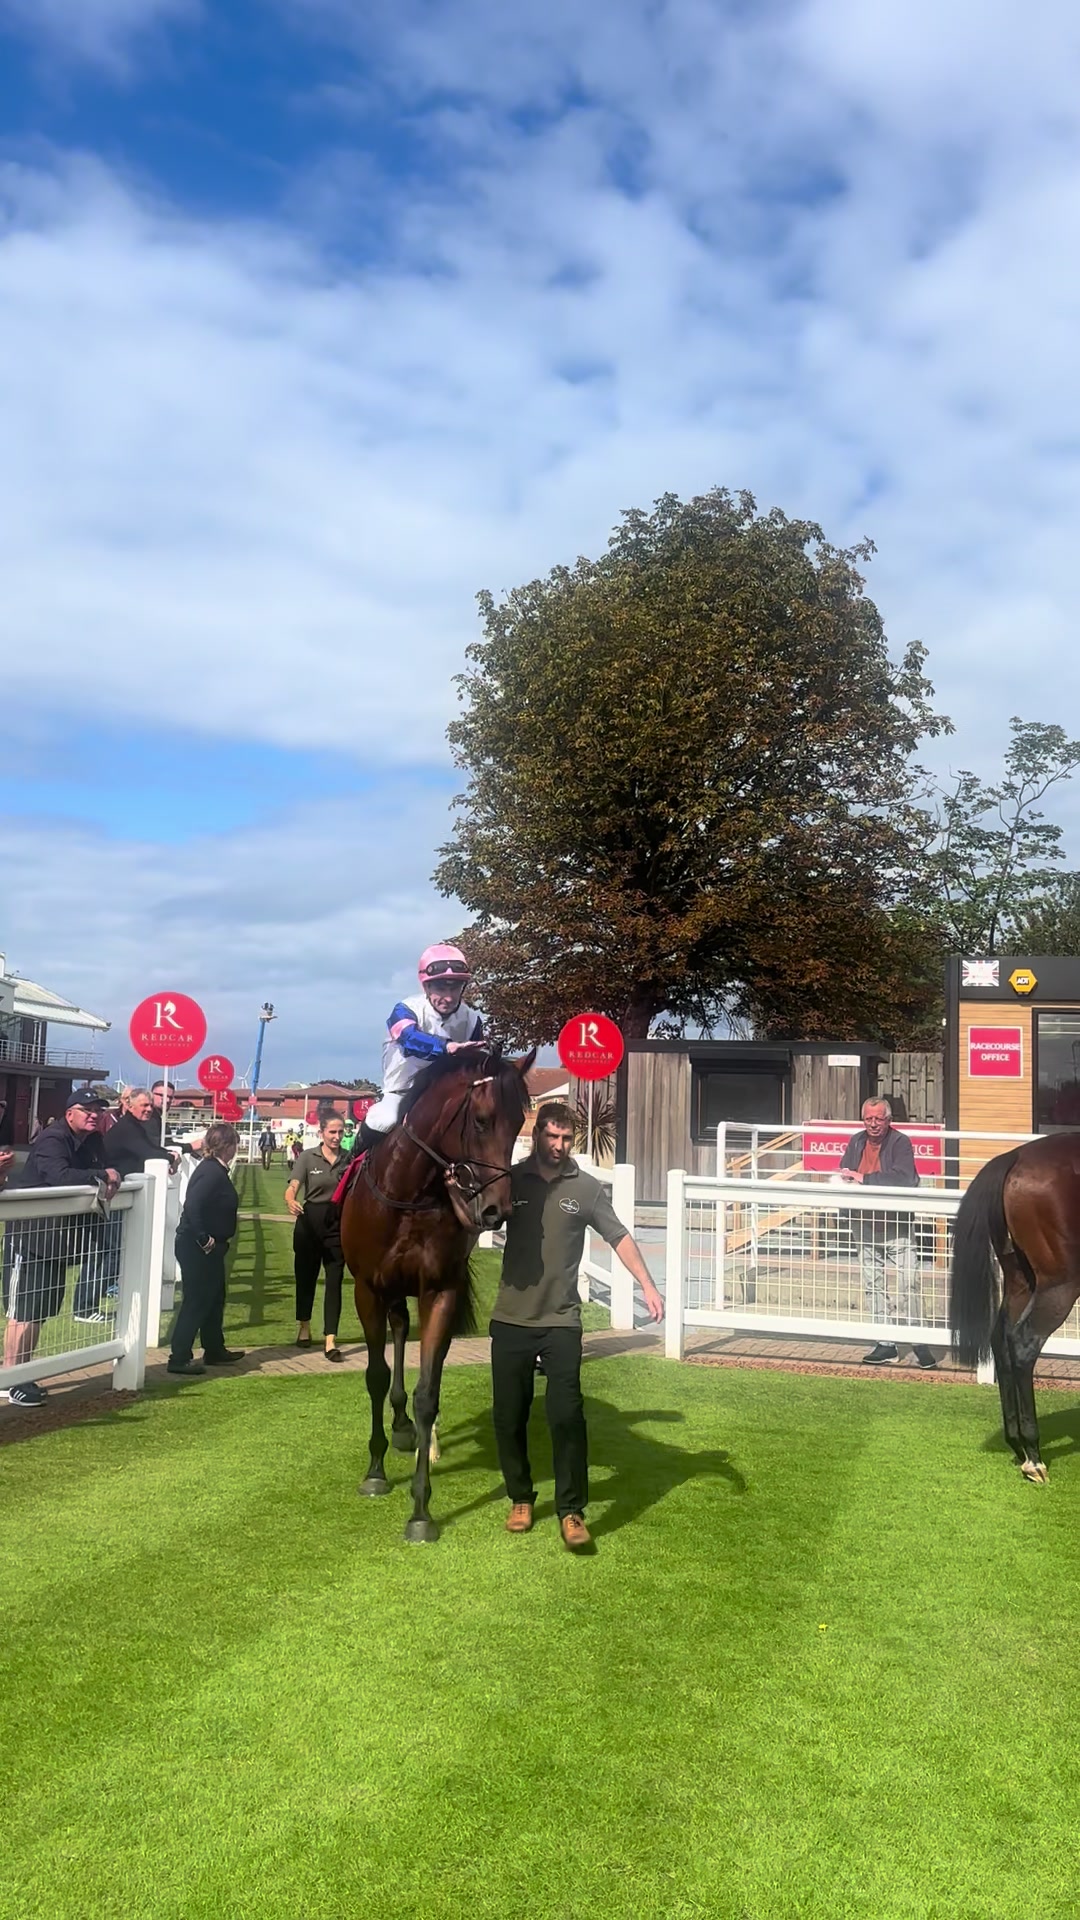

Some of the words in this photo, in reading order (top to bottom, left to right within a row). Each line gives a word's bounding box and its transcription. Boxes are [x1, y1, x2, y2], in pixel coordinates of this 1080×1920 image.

[141, 1033, 193, 1042] REDCAR
[569, 1051, 614, 1059] REDCAR
[810, 1141, 849, 1153] RACEC
[912, 1144, 935, 1156] ICE
